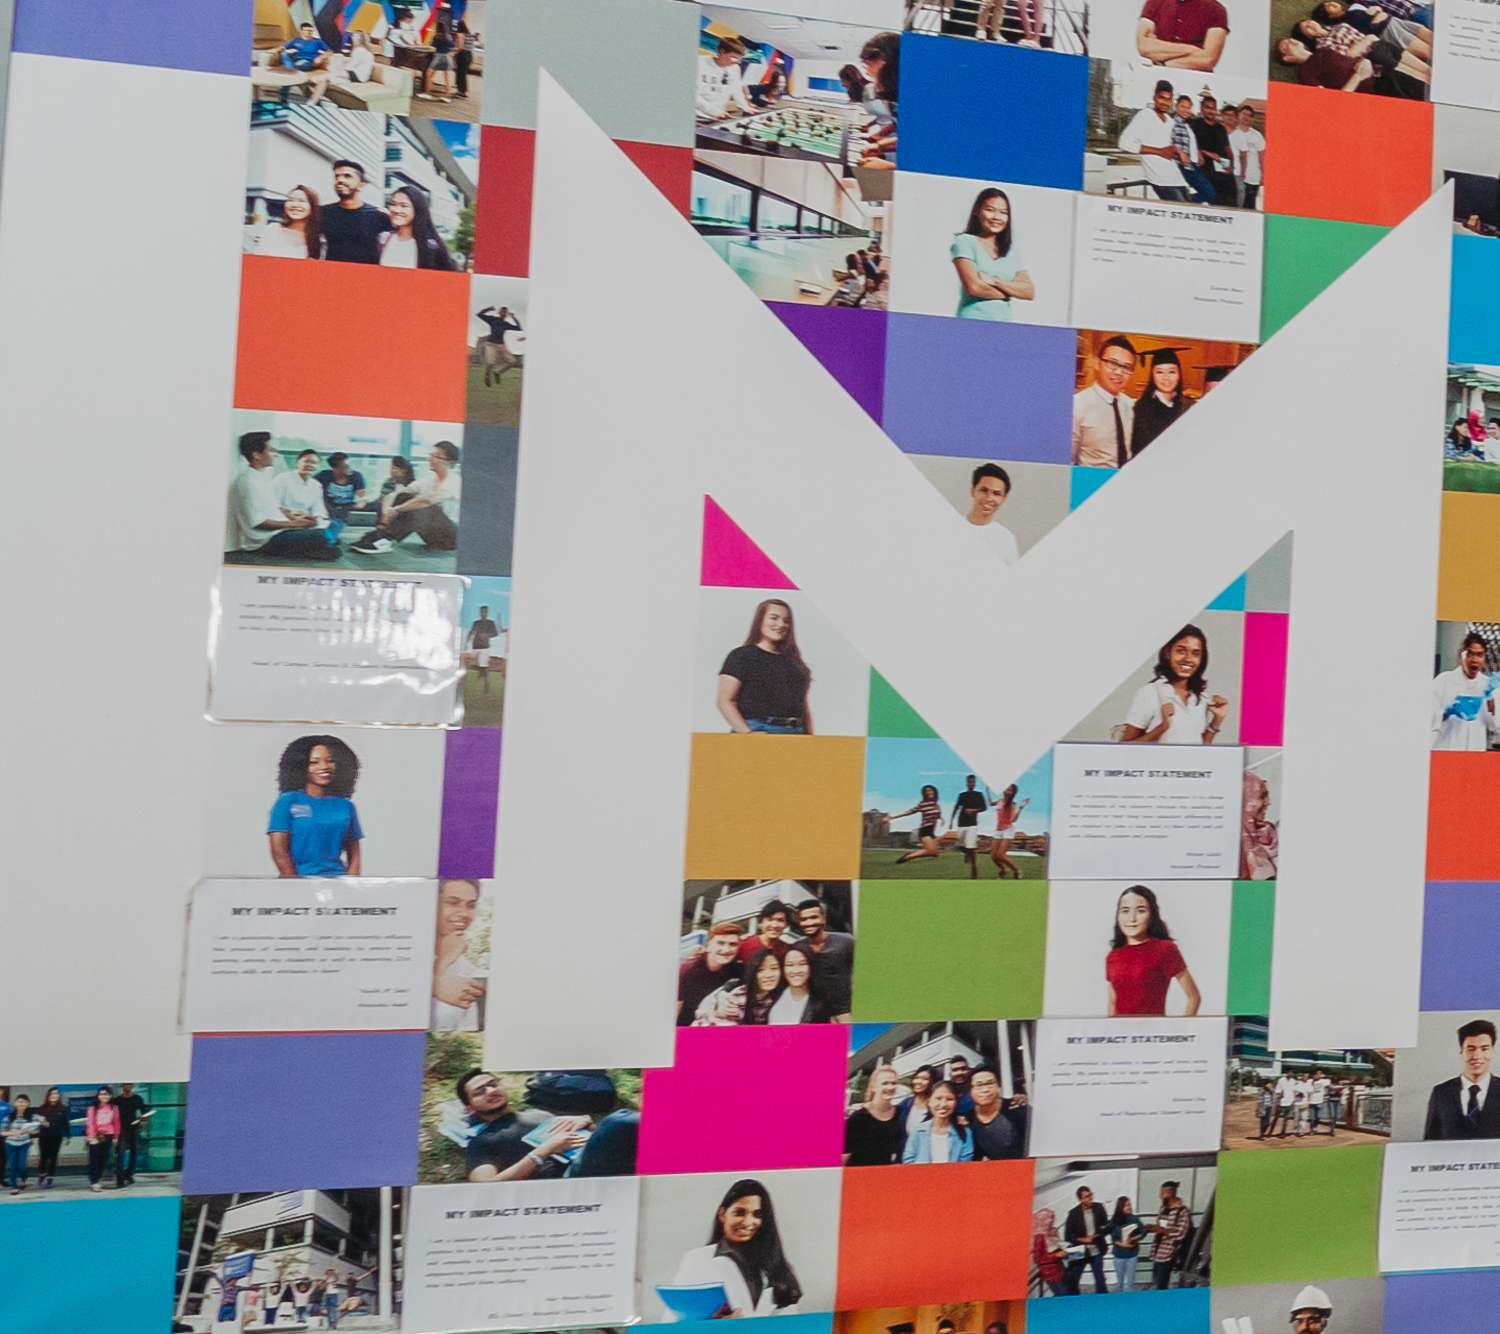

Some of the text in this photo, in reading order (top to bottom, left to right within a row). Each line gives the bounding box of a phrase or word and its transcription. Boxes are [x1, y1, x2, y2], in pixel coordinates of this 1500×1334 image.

[1107, 205, 1233, 224] MY IMPACT STATEMENT
[257, 575, 279, 584] MY
[282, 576, 336, 586] IMPACT
[1086, 1036, 1128, 1044] IMPACT
[1131, 1035, 1195, 1043] STATEMENT
[1428, 1163, 1465, 1172] IMPACT
[445, 1204, 601, 1219] MY IMPACT STATEMENT
